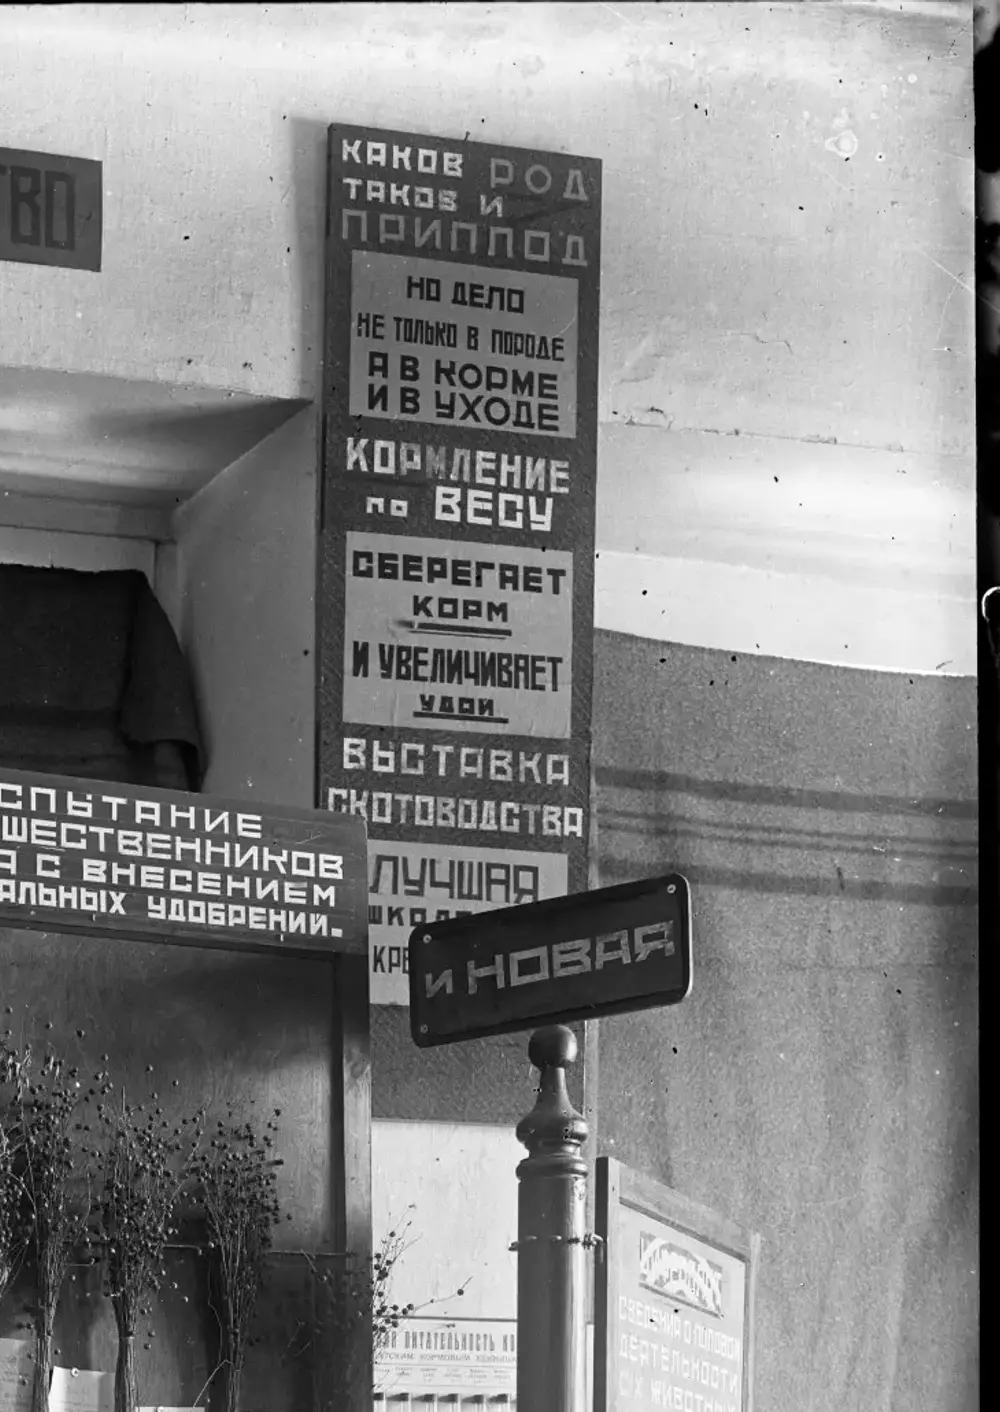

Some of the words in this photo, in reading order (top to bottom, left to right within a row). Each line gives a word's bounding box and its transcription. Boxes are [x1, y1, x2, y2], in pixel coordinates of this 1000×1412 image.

[342, 138, 464, 178] КАКОВ
[489, 157, 589, 201] РОД
[342, 178, 458, 212] ТАКОВ
[480, 194, 504, 218] И
[341, 208, 588, 267] ПРИПЛОД
[407, 275, 441, 302] НО
[451, 280, 525, 314] ДЕЛО
[357, 311, 385, 341] НЕ
[393, 315, 458, 349] ТОЛЬКО
[467, 325, 479, 351] В
[491, 329, 565, 362] ПОРОДЕ
[368, 351, 389, 380] А
[400, 354, 420, 382] В
[435, 359, 559, 400] КОРМЕ
[368, 383, 388, 412] И
[400, 387, 420, 414] В
[435, 391, 559, 432] УХОДЕ
[346, 437, 570, 494] КОРМЛЕНИЕ
[366, 496, 408, 518] ПО
[435, 486, 553, 532] ВЕСУ
[352, 550, 567, 595] СБЕРЕГАЕТ
[413, 595, 508, 623] КОРМ
[352, 641, 369, 678] И
[379, 643, 563, 692] УВЕЛИЧИВАЕТ
[342, 737, 570, 786] ВЫСТАВКА
[327, 786, 583, 838] СКОТОВОДСТВА
[36, 854, 61, 879] С
[82, 858, 336, 908] ВНЕСЕНИЕМ
[369, 854, 539, 905] ЛУЧШАЯ
[147, 897, 344, 939] УДОБРЕНИЙ.
[425, 969, 454, 998] И
[466, 919, 676, 996] НОВАЯ
[404, 1331, 495, 1352] ПИТАТЕЛЬНОСТЬ
[619, 1295, 681, 1340] СВЕДЕНИЯ
[683, 1319, 692, 1344] О
[619, 1334, 738, 1398] ДЕЯТЕЛЬНОСТИ
